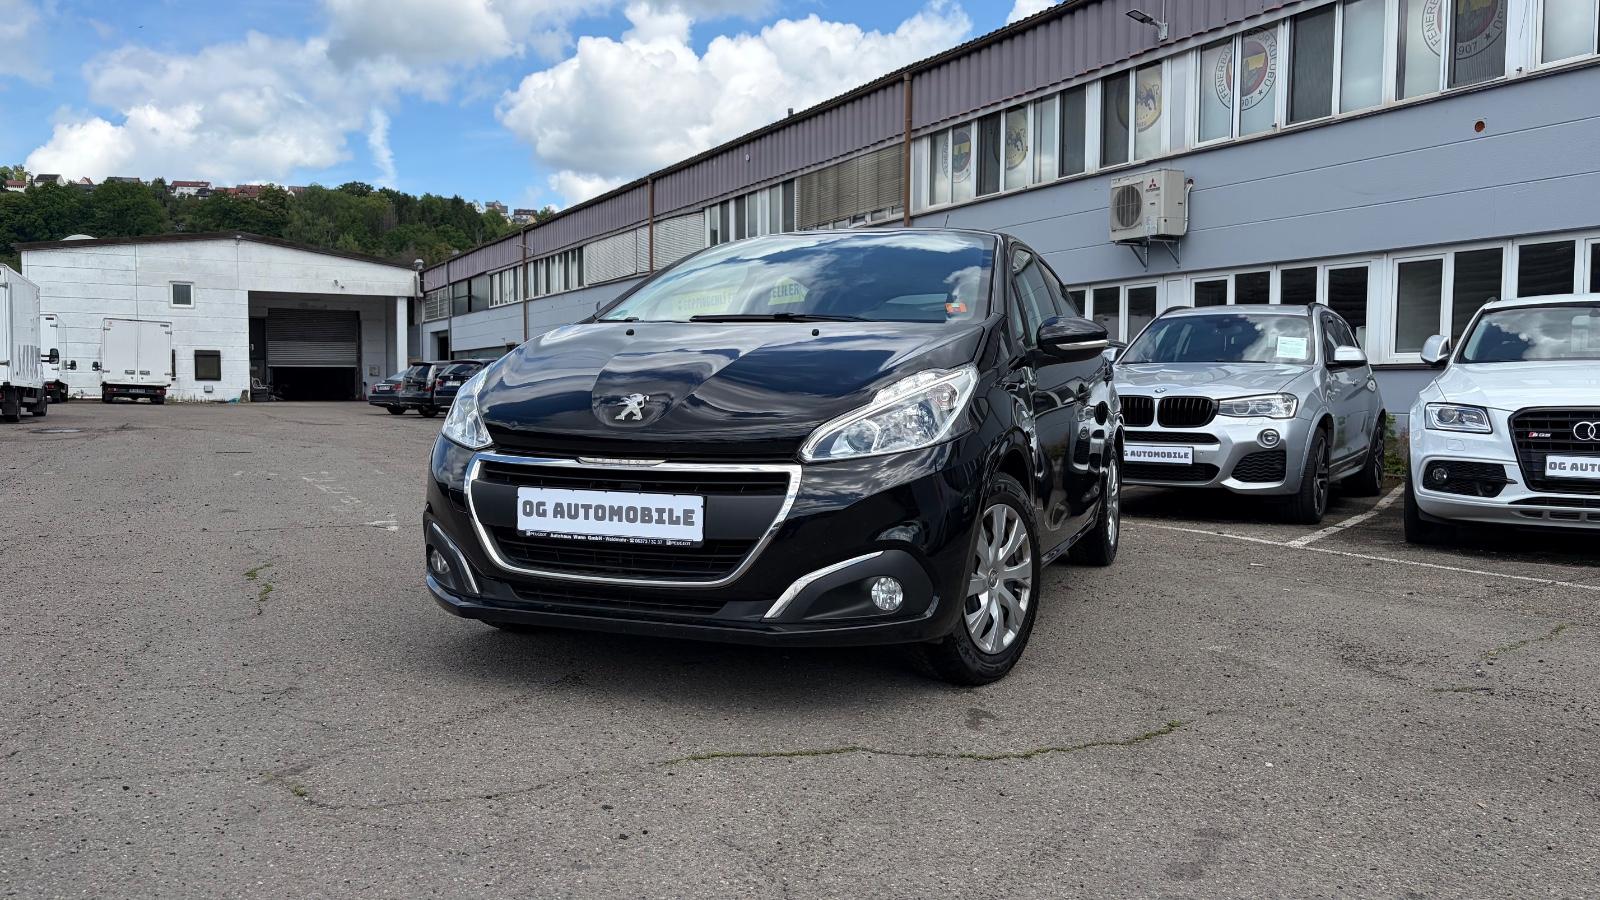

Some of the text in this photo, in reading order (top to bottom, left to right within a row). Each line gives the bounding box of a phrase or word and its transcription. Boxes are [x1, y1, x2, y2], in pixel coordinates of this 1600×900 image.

[1457, 41, 1477, 55] 907
[1130, 451, 1189, 459] AUTOMOBILE
[1548, 462, 1566, 470] OG
[522, 500, 695, 527] OG AUTOMOBILE
